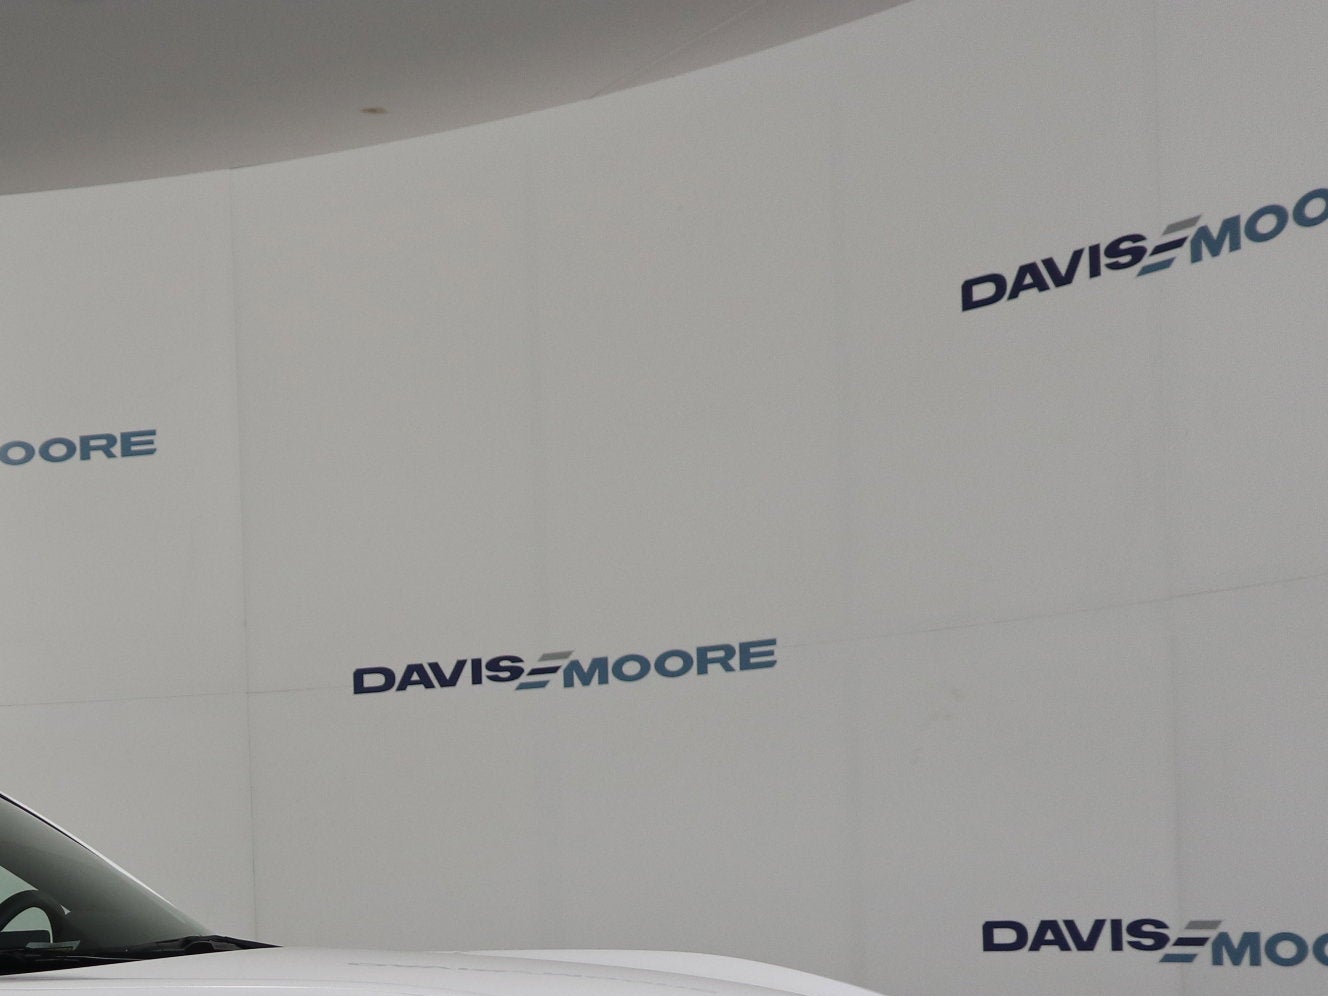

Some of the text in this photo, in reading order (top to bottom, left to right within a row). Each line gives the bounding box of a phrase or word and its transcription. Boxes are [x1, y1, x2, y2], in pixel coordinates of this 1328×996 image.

[961, 233, 1149, 312] DAVIS
[353, 638, 777, 695] DAVIS MOORE
[982, 918, 1170, 952] DAVIS
